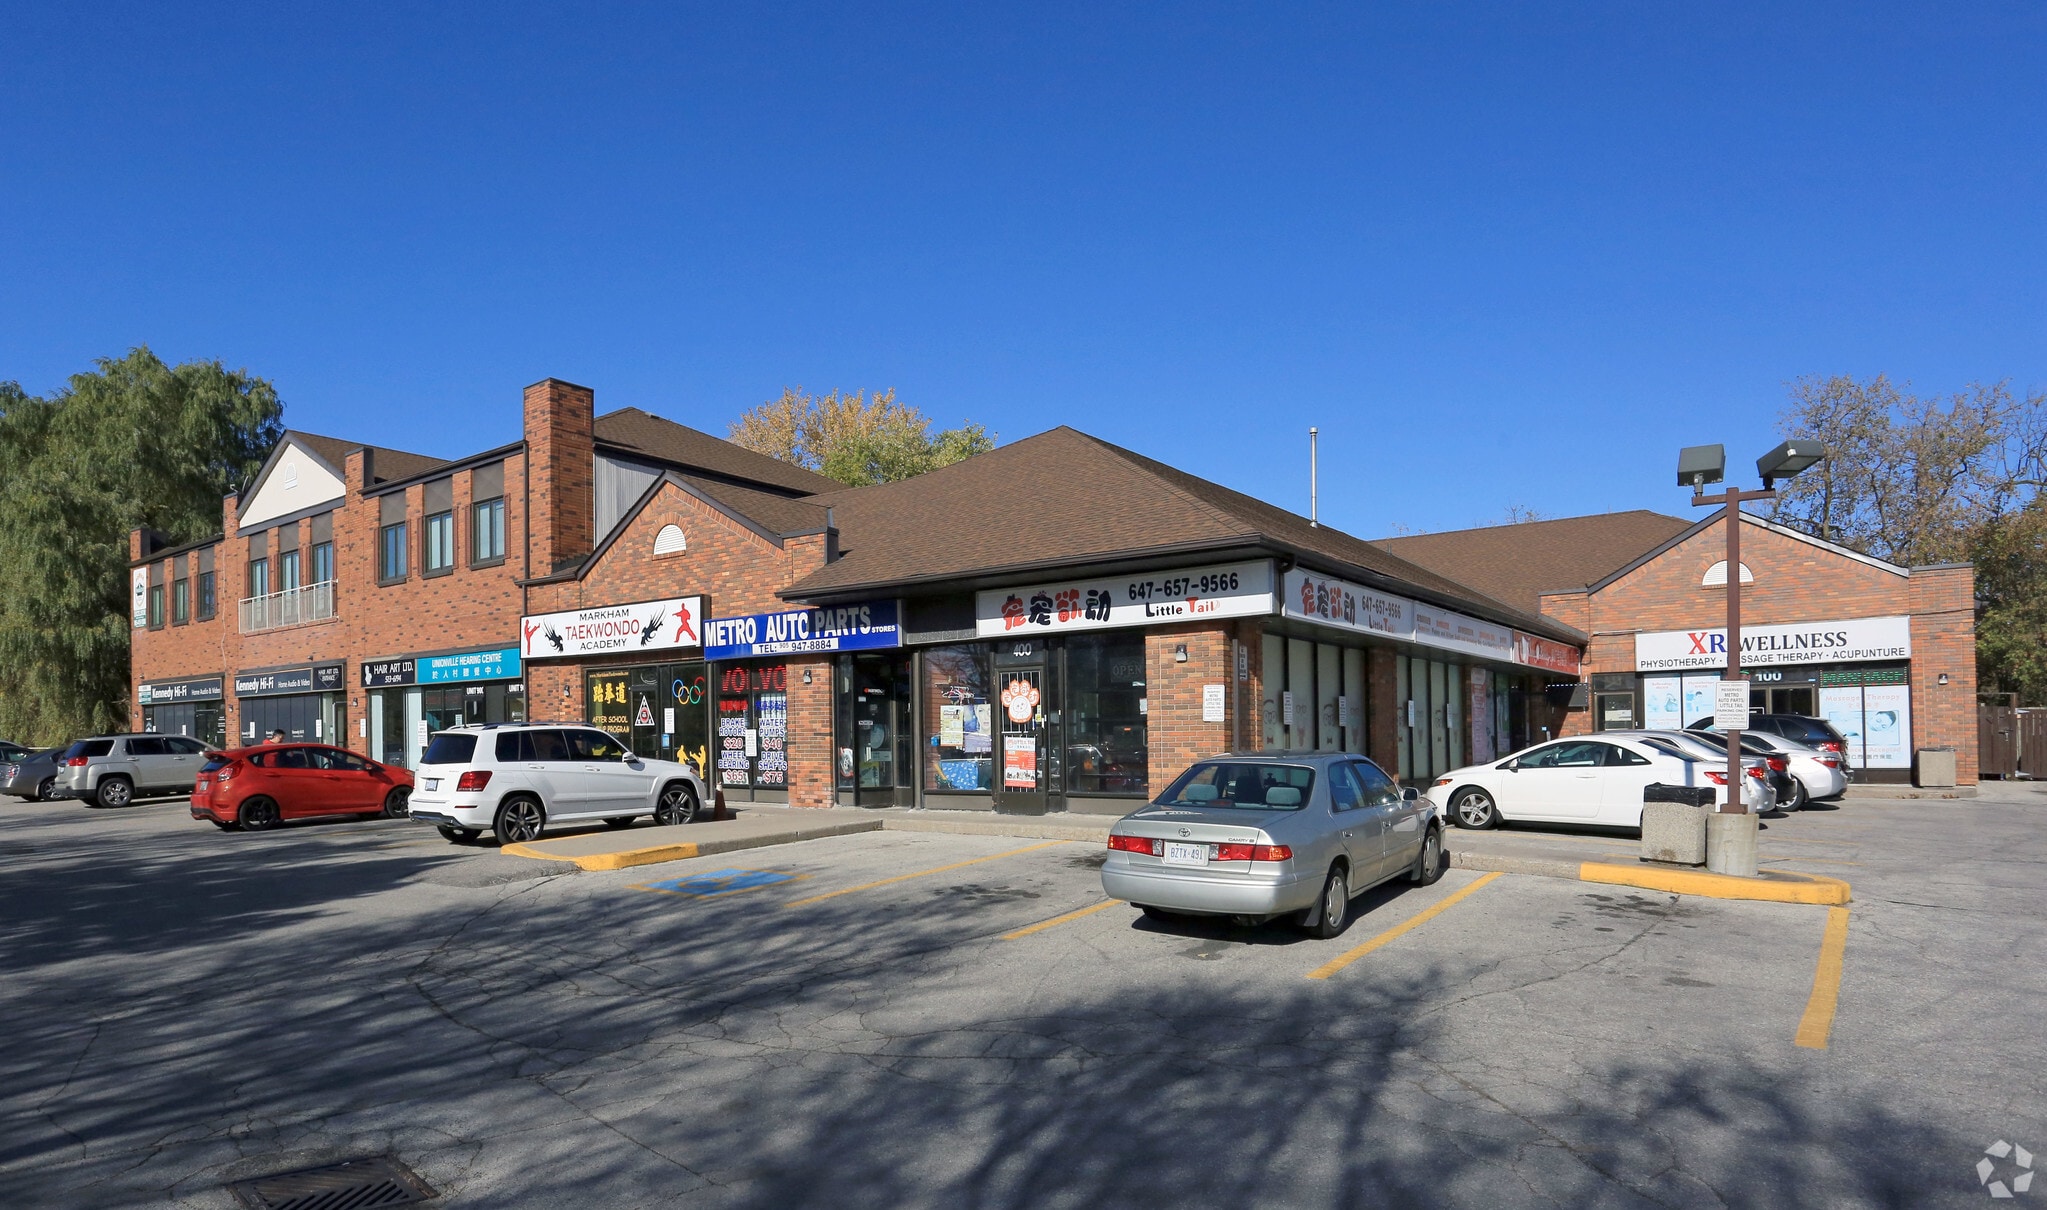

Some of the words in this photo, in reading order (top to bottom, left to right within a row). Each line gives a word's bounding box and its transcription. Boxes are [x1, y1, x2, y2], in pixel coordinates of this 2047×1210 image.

[1128, 572, 1239, 600] 647-657-9566
[1145, 602, 1183, 618] Little
[1185, 596, 1214, 613] Tail
[1361, 595, 1401, 619] 647-657-9566
[580, 609, 629, 621] MARKHAM
[565, 619, 640, 640] TAEKWONDO
[704, 617, 757, 648] METRO
[765, 612, 809, 643] AUTO
[814, 606, 871, 639] PARTS
[871, 625, 896, 634] STORES
[580, 638, 627, 651] ACADEMY
[758, 644, 778, 654] TEL:
[791, 639, 832, 652] 947-8884
[1739, 631, 1848, 651] WELLNESS
[1013, 643, 1032, 657] 400
[431, 657, 459, 668] UNIONVILLE
[459, 654, 481, 665] HEARING
[481, 652, 502, 663] CENTRE
[1640, 657, 1717, 669] PHYSIOTHERAPY
[1776, 651, 1824, 663] THERAPY
[1832, 647, 1906, 659] ACUPUNTURE
[373, 664, 388, 675] HAIR
[389, 662, 401, 673] ART
[402, 661, 414, 672] LTD.
[721, 666, 787, 693] VOLVO
[1755, 672, 1782, 682] 100
[235, 679, 260, 694] Kennedy
[260, 677, 274, 690] Hi-Fi
[152, 686, 174, 701] Kennedy
[174, 685, 187, 697] Hi-Fi
[593, 681, 627, 704] 跆拳道
[592, 715, 608, 724] AFTER
[608, 715, 629, 723] SCHOOL
[721, 718, 745, 727] BRAKE
[759, 718, 785, 727] WATER
[719, 727, 747, 736] ROTORS
[759, 727, 785, 736] PUMPS
[724, 737, 743, 749] $20
[763, 738, 782, 750] $40
[721, 751, 746, 759] WHEEL
[761, 751, 784, 760] DRIVE
[718, 759, 749, 769] BEARING
[758, 760, 787, 770] SHAFTS
[726, 770, 744, 781] $65
[763, 771, 783, 783] $75
